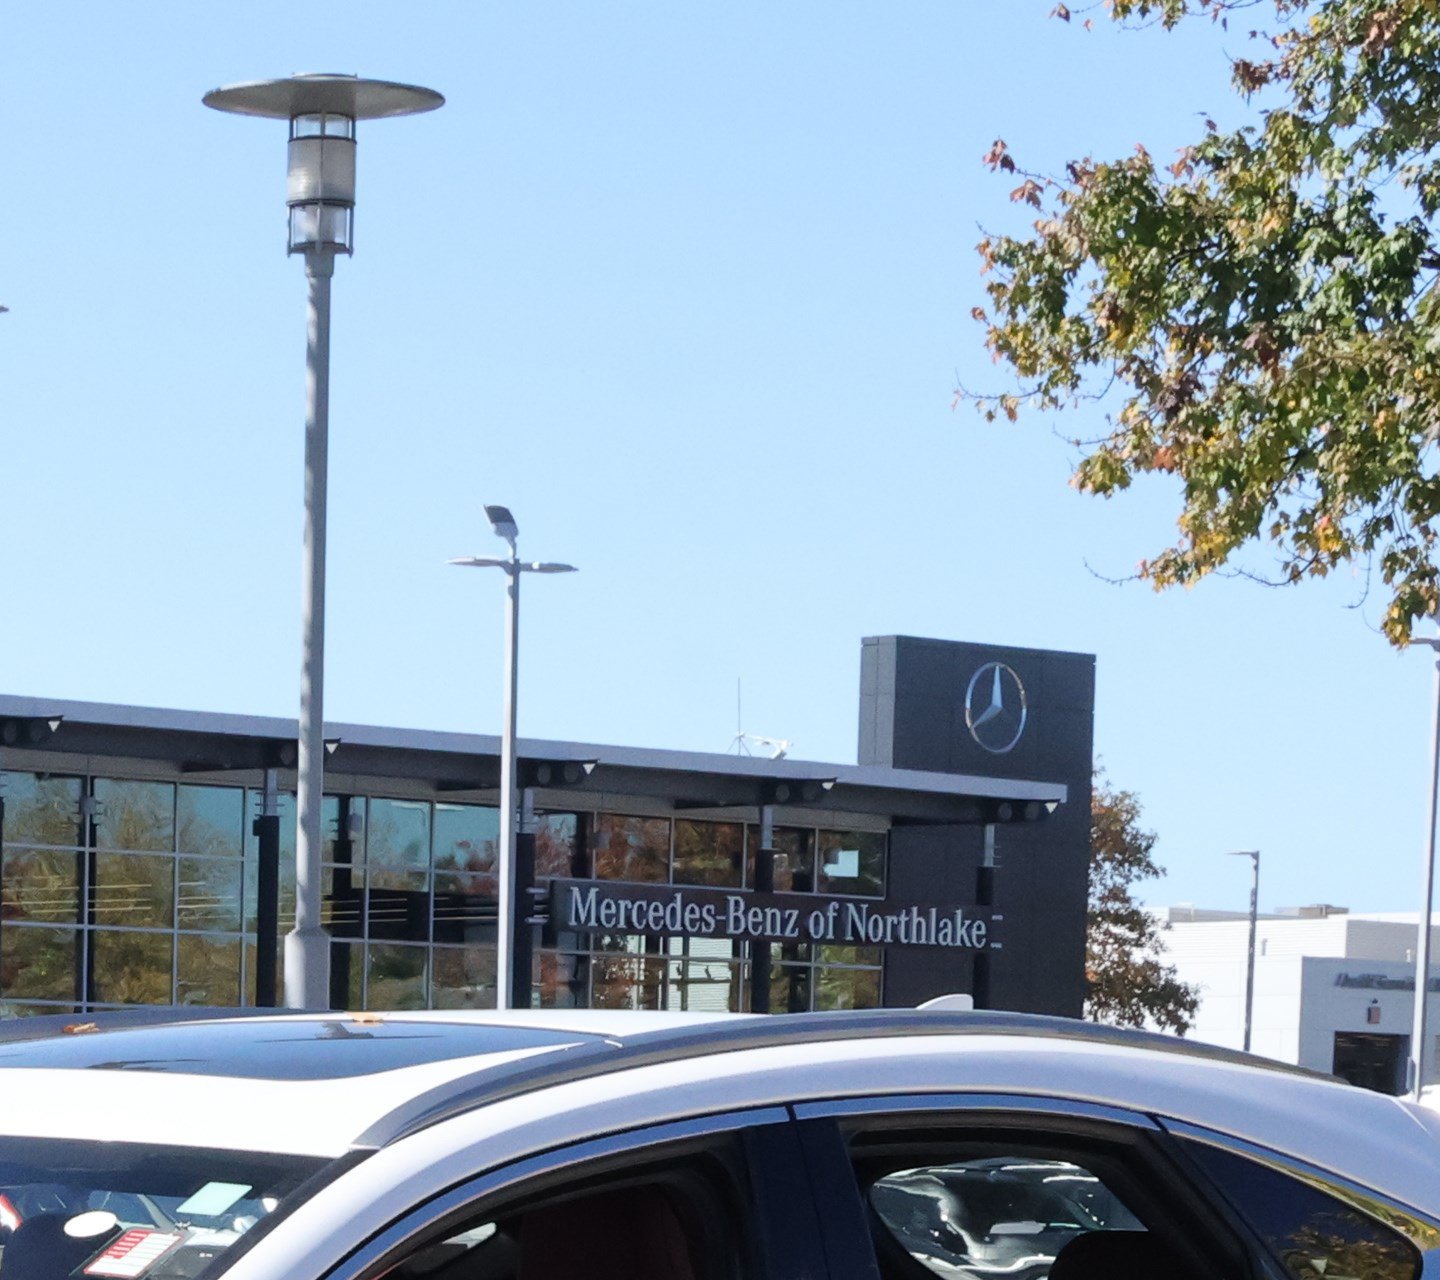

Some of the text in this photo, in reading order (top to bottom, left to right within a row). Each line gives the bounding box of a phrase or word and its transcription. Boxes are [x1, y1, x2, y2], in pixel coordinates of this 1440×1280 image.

[568, 886, 987, 949] Mercedes-Benz of Northlake
